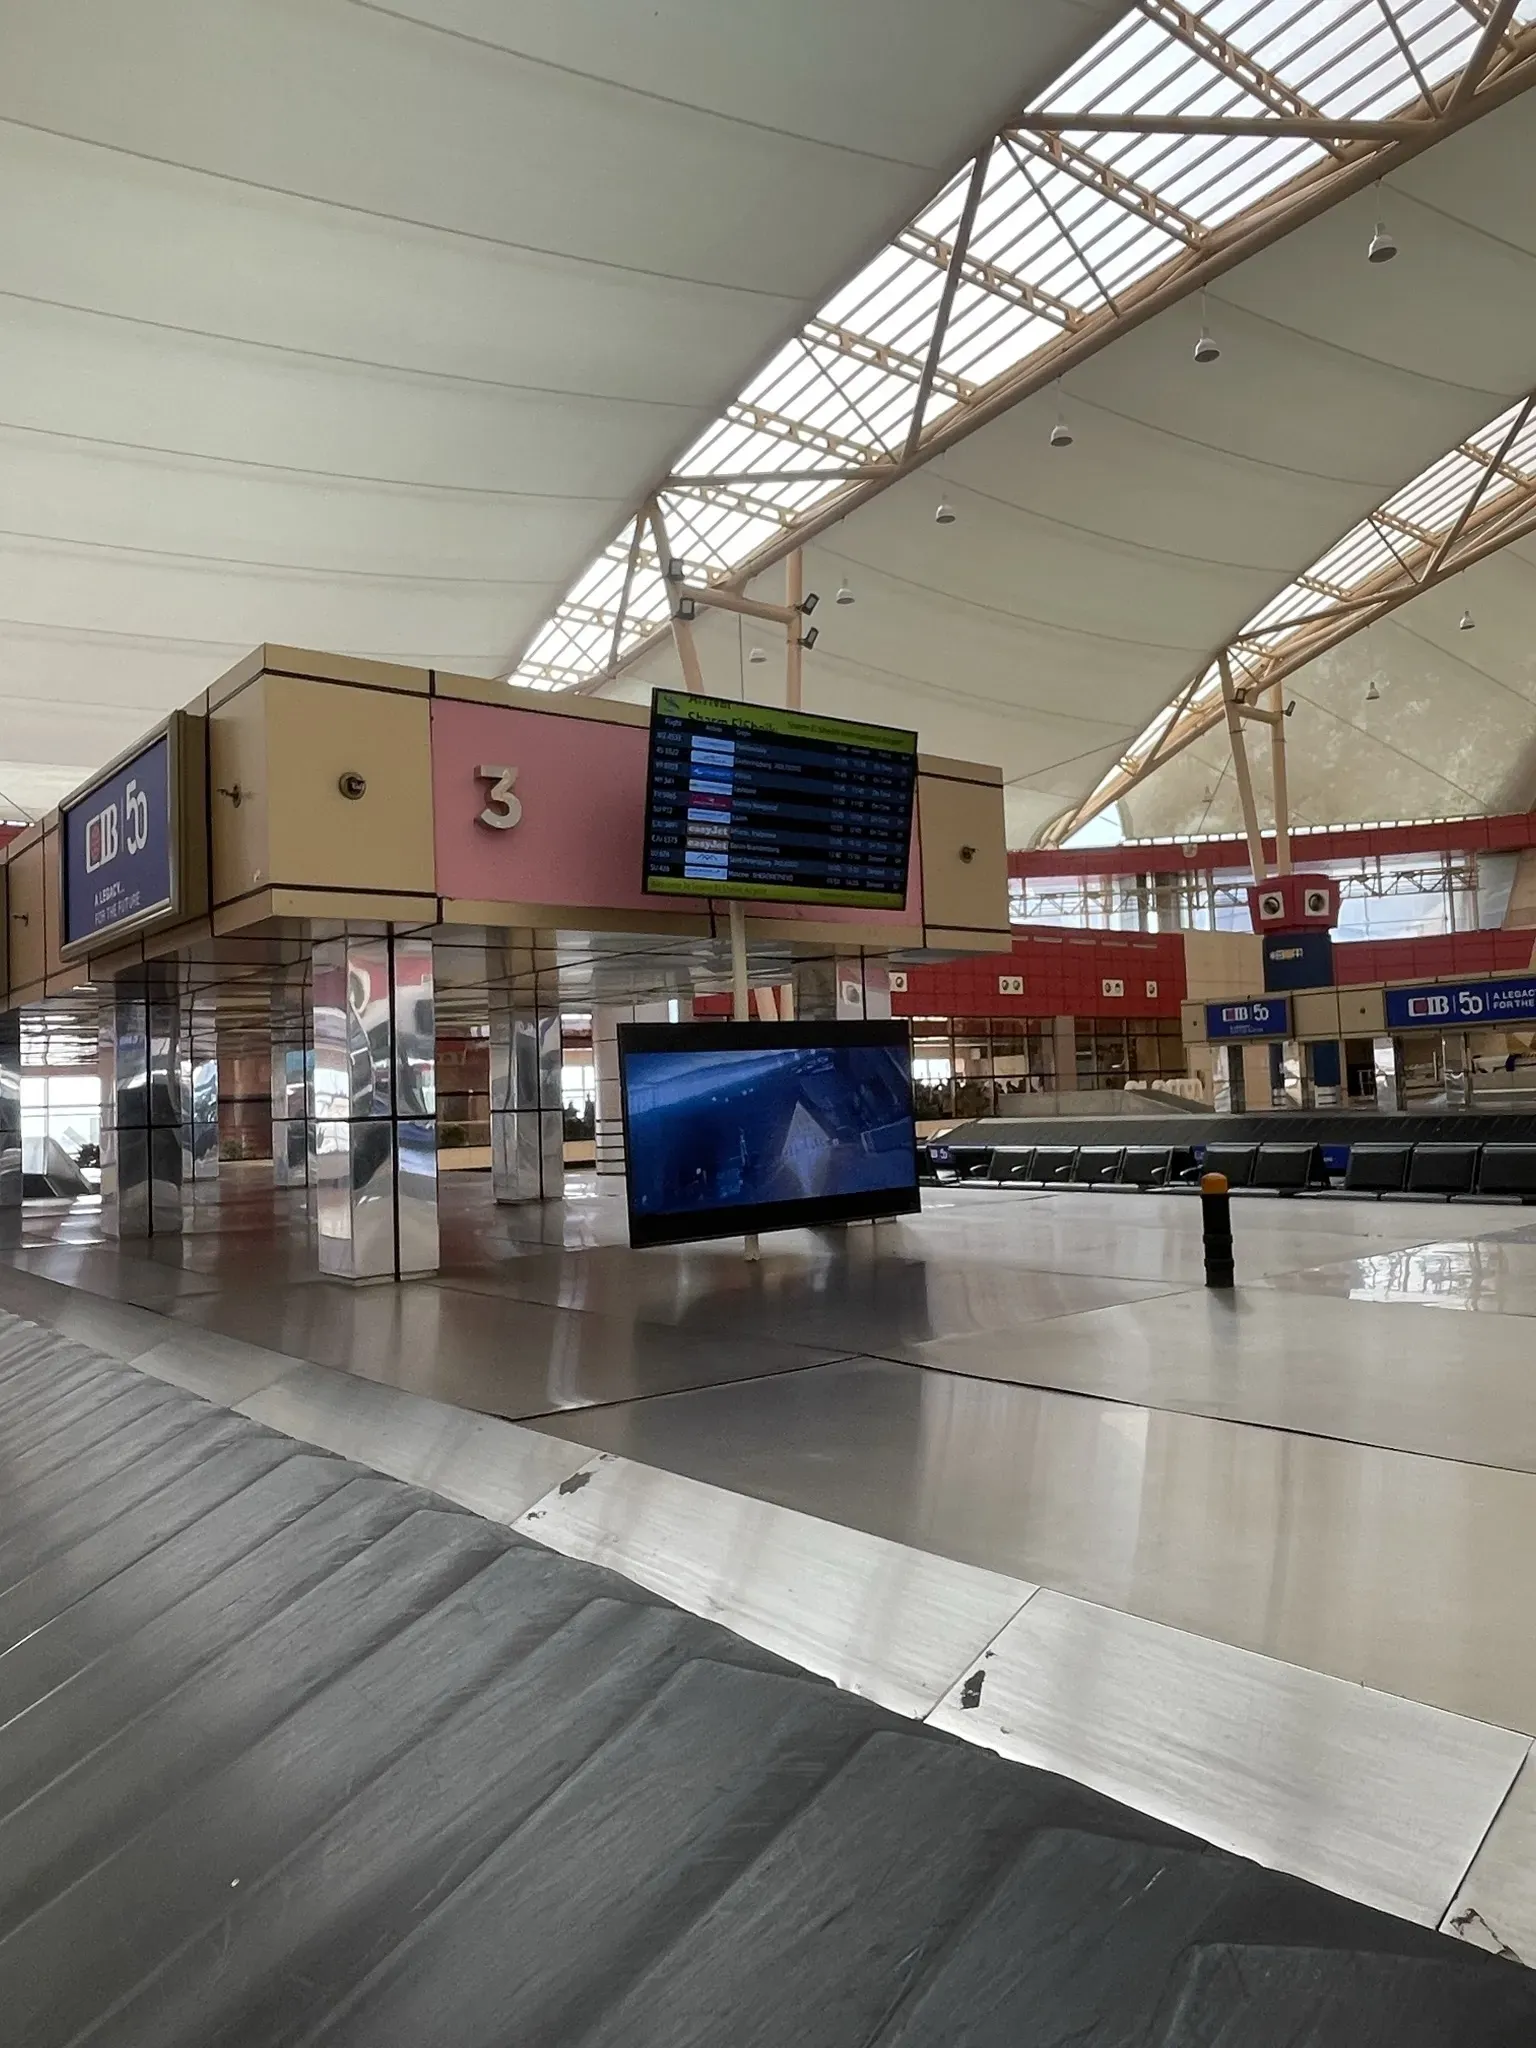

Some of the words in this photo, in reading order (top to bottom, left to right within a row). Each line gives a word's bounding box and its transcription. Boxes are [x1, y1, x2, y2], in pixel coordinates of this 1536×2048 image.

[473, 765, 523, 829] 3
[85, 802, 119, 875] CIB
[126, 778, 148, 855] 50
[94, 893, 99, 907] A
[94, 909, 106, 926] FOR
[106, 902, 117, 921] THE
[117, 890, 141, 915] FUTURE
[1408, 995, 1450, 1018] CIB
[1459, 991, 1483, 1015] 50
[1493, 992, 1501, 1000] A
[1502, 989, 1536, 1000] LEGAC
[1493, 1000, 1514, 1009] FOR
[1514, 998, 1535, 1008] THE
[1222, 1006, 1248, 1022] CIB
[1253, 1003, 1270, 1022] 50
